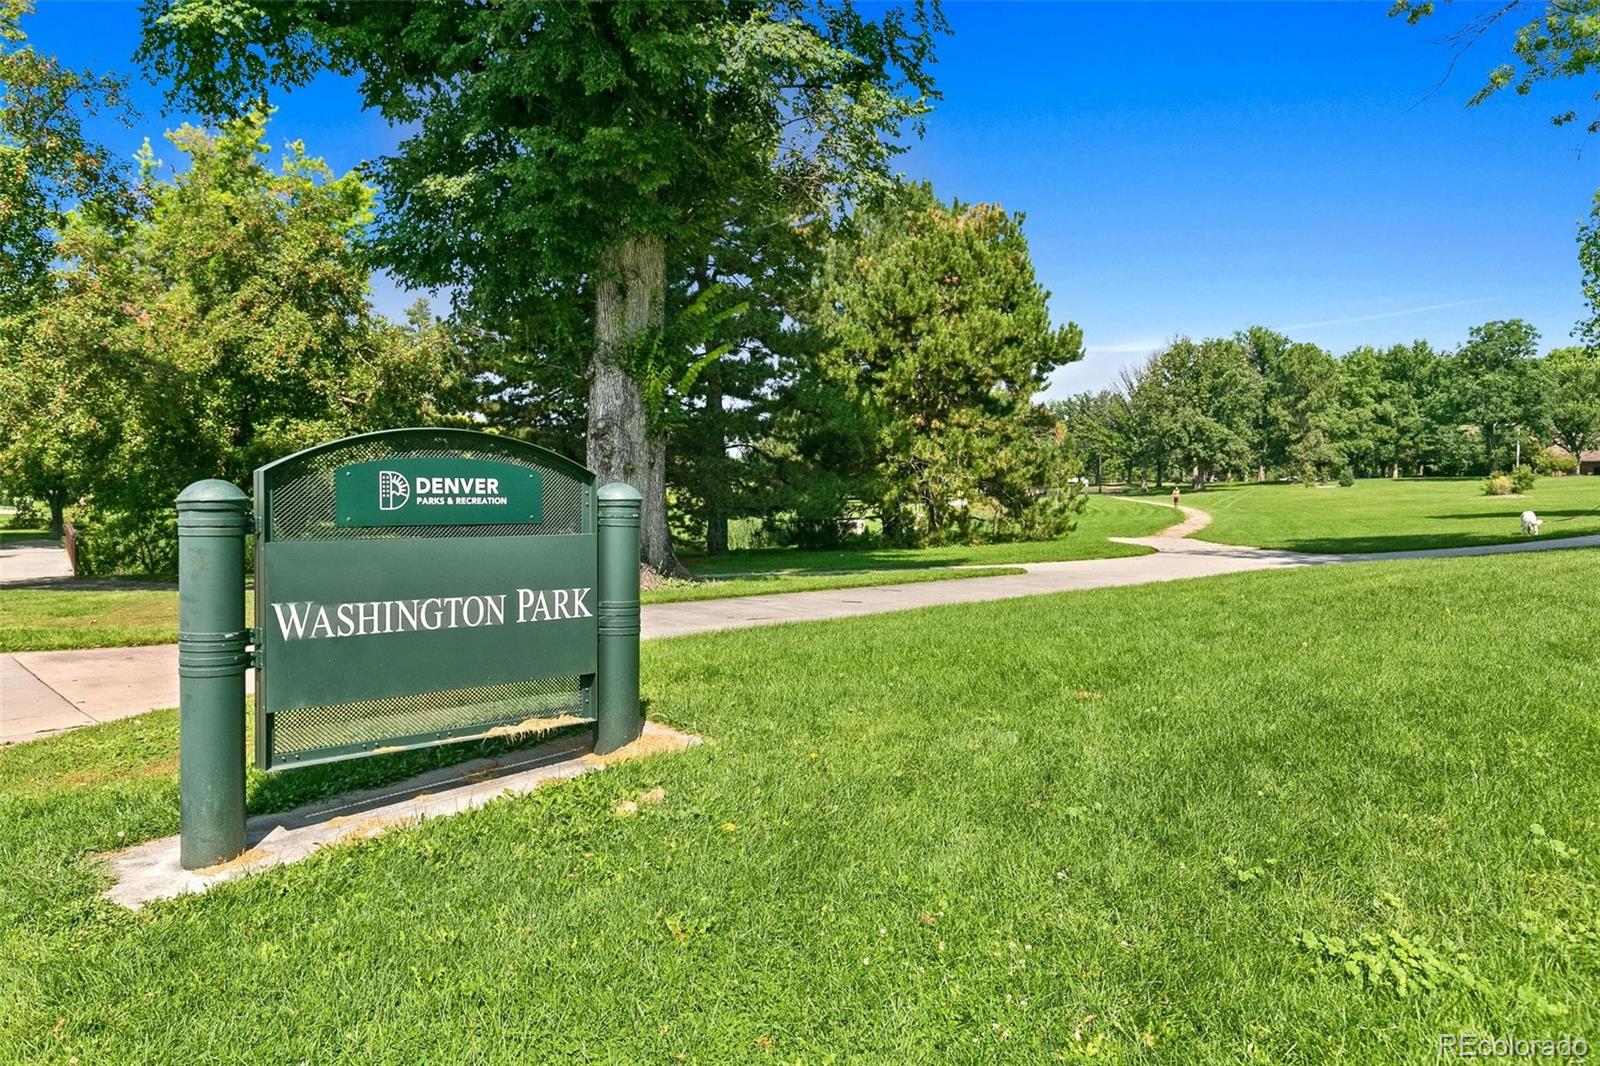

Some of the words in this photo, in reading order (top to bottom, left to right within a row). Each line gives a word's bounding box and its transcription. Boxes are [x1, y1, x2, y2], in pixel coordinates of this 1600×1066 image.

[416, 477, 499, 495] DENVER
[416, 497, 445, 505] PARKS
[447, 497, 453, 505] &
[455, 497, 508, 505] RECREATION
[271, 594, 507, 642] WASHINGTON
[516, 587, 594, 624] PARK
